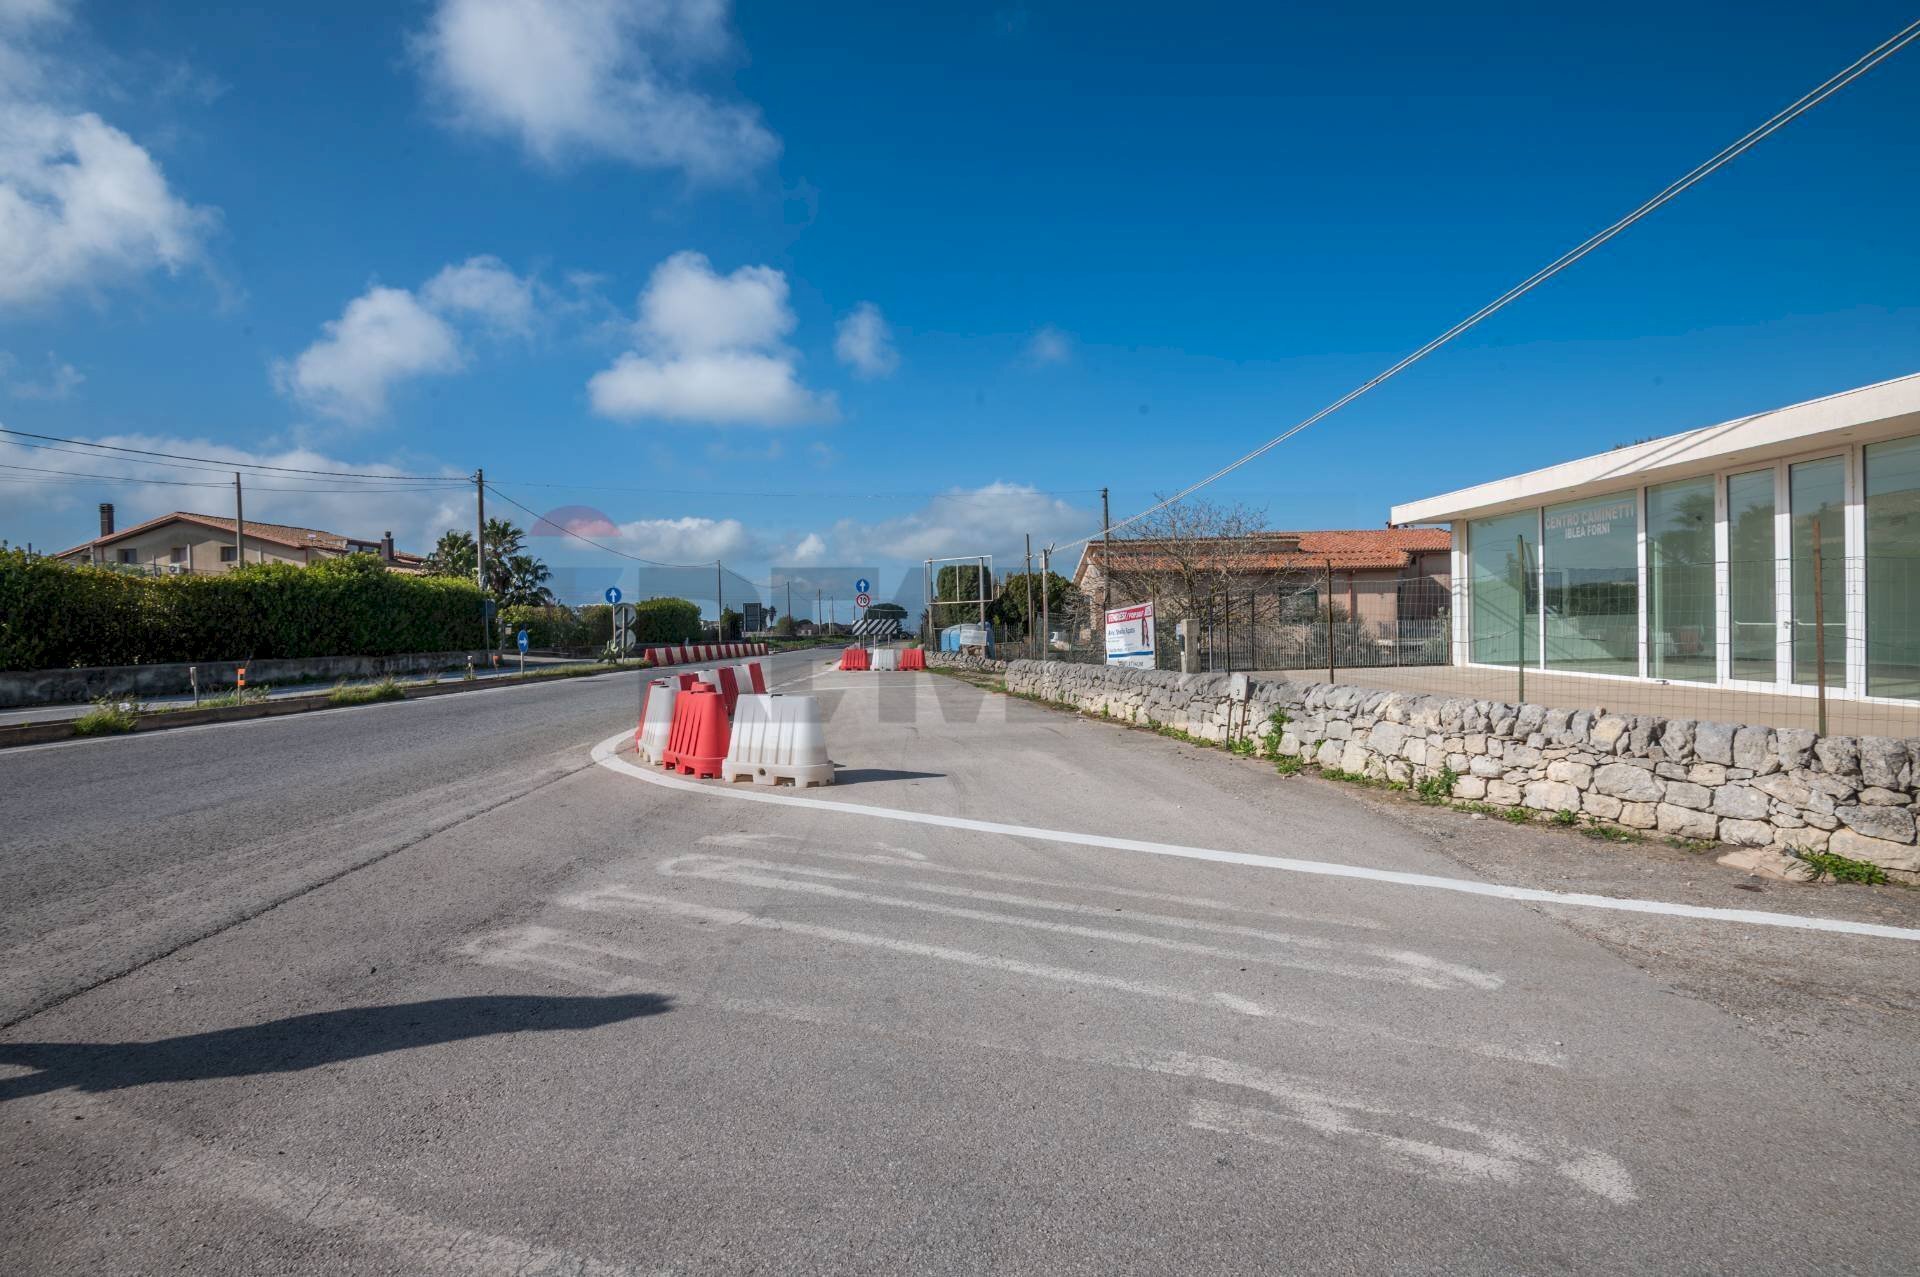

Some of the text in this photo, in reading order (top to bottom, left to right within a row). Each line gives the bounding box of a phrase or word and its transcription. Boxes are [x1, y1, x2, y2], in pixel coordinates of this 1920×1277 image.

[1545, 504, 1634, 530] CENTRO CAMINETTI
[1565, 521, 1610, 539] IBLEA FORNI
